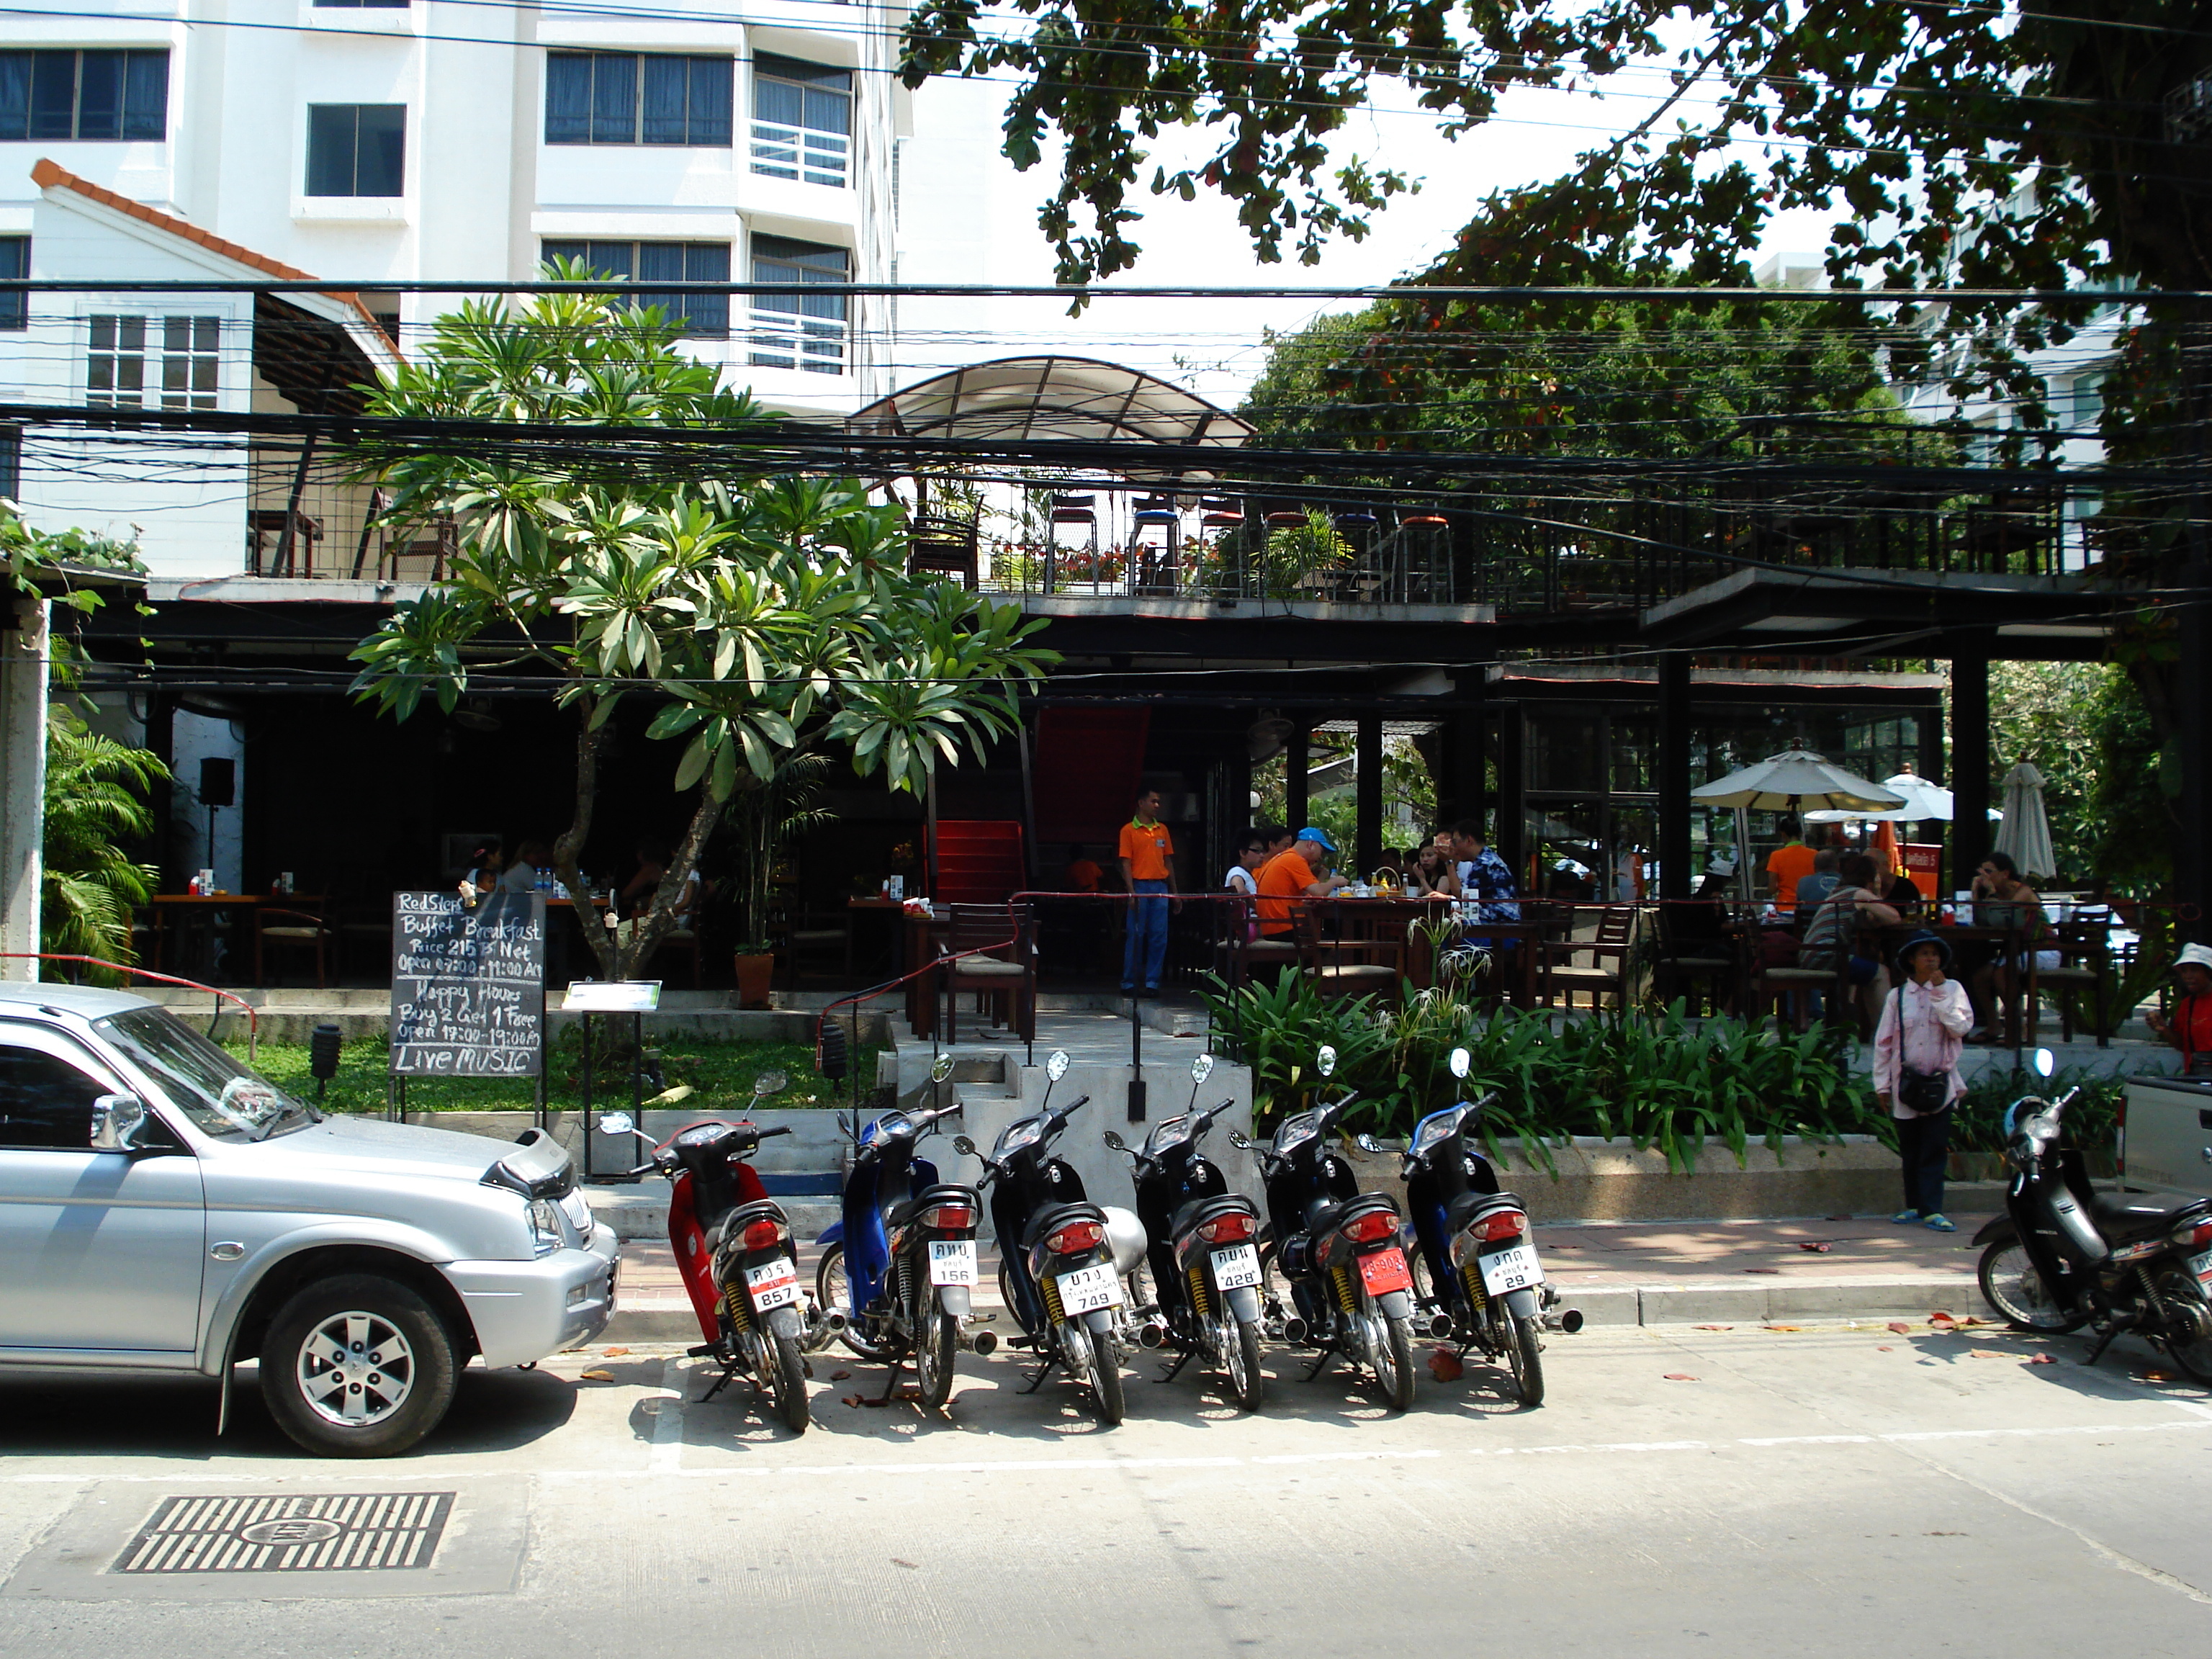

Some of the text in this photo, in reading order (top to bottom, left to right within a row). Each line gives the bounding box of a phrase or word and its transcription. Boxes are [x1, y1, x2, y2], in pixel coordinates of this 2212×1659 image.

[400, 915, 542, 943] Buffet Breakfast
[409, 938, 445, 953] Price
[447, 938, 477, 958] 215
[500, 940, 531, 962] Net
[397, 953, 431, 974] Open
[416, 979, 469, 1010] Happy
[397, 1003, 536, 1028] Buy 2 Get 1 Free
[397, 1023, 436, 1043] Open
[941, 1270, 969, 1282] 156
[1226, 1272, 1254, 1287] 428
[1505, 1274, 1525, 1289] 29
[761, 1287, 791, 1306] 857
[1077, 1292, 1110, 1310] 749
